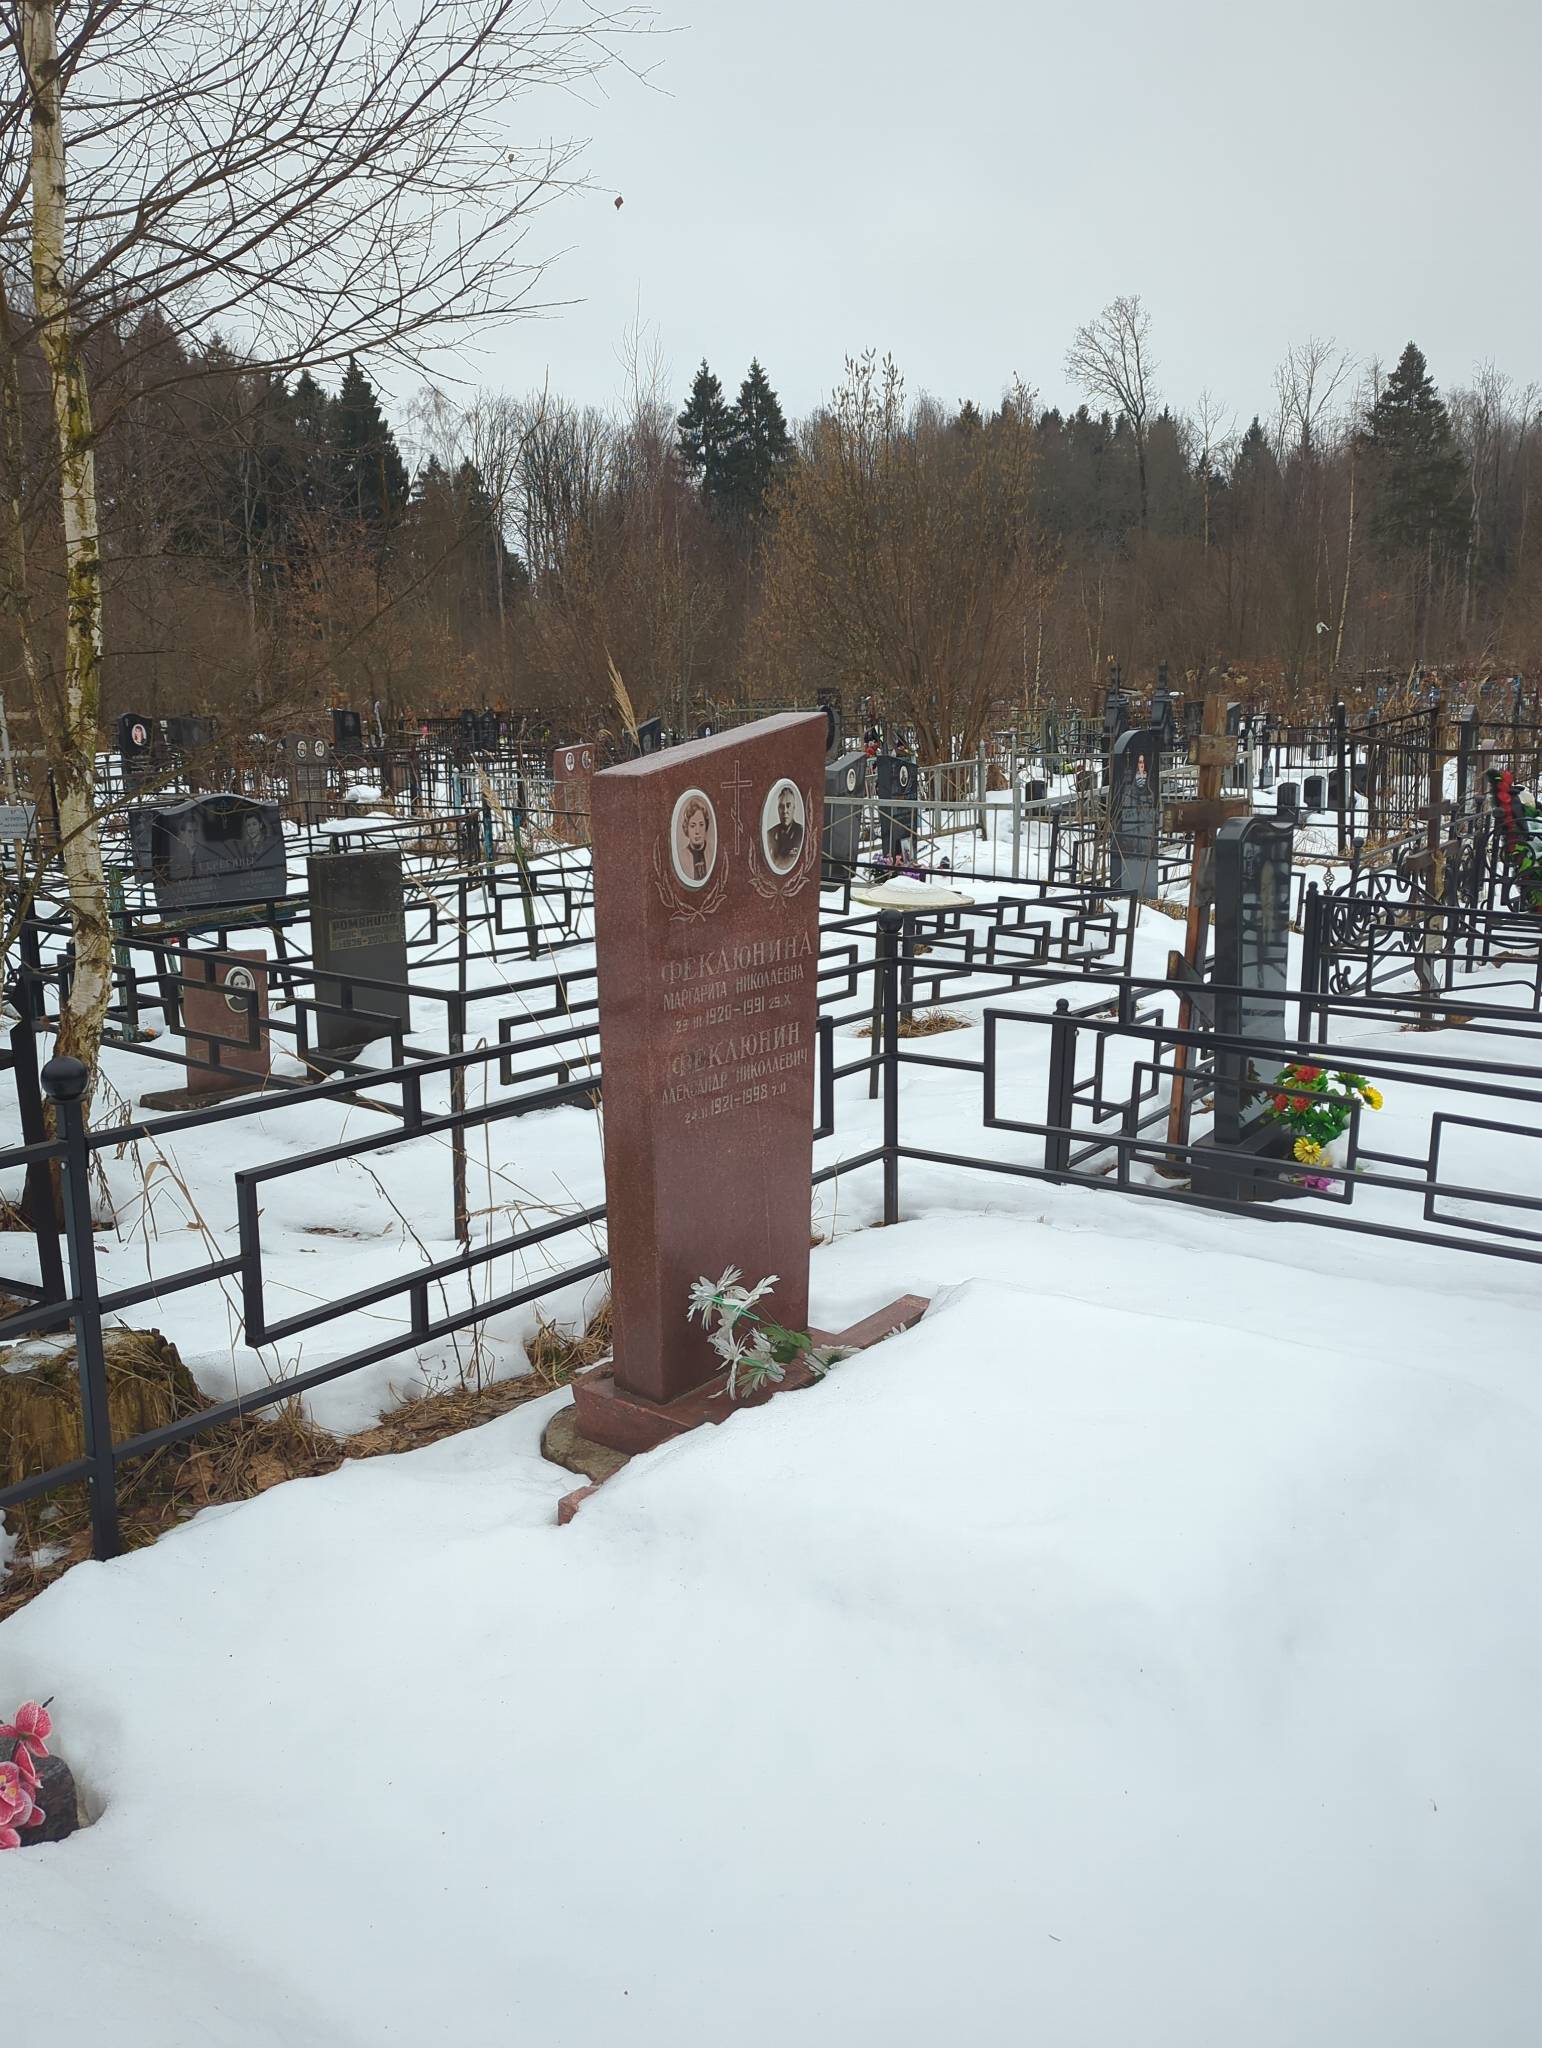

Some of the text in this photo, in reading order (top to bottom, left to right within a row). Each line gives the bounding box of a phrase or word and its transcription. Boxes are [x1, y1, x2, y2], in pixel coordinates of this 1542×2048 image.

[661, 930, 813, 985] ФЕКЛЮНИНА
[663, 964, 805, 1012] МАРГАРИТА НИКОЛАЕВНА
[662, 1048, 808, 1104] АЛЕКСАНДР НИКОЛАЕВИЧ
[672, 1021, 801, 1077] ФЕКЛЮНИН
